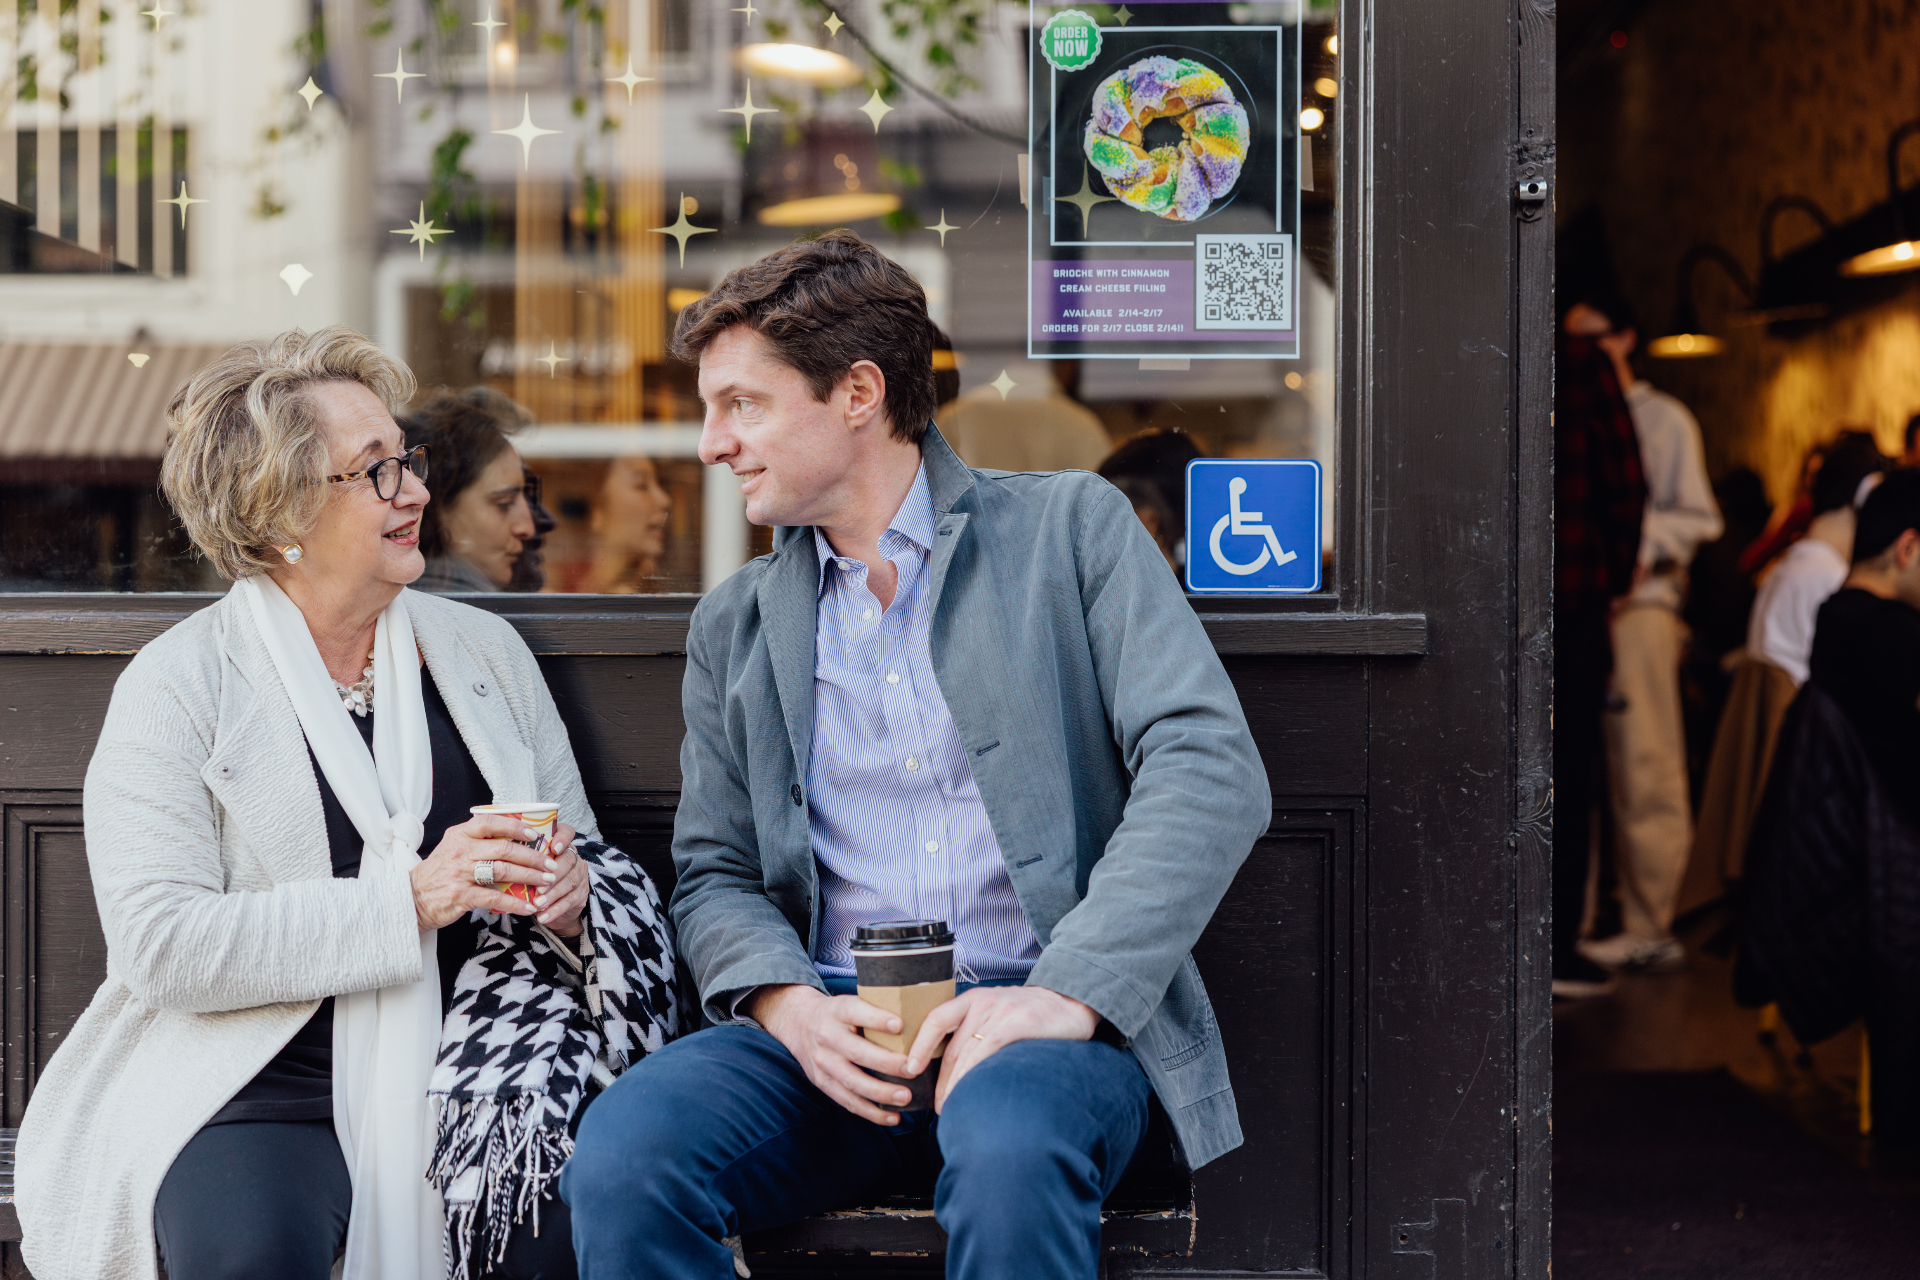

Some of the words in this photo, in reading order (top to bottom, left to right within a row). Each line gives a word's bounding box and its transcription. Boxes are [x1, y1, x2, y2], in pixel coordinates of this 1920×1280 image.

[1053, 26, 1088, 39] ORDER
[1053, 39, 1089, 57] NOW
[1053, 269, 1094, 278] BRIOCHE
[1096, 269, 1119, 278] WITH
[1121, 269, 1170, 278] CINNAMON
[1059, 284, 1093, 293] CREAM
[1095, 284, 1131, 293] CHEESE
[1062, 309, 1113, 318] AVAILABLE
[1118, 309, 1163, 318] 2/14-2/17
[1042, 324, 1079, 333] ORDERS
[1081, 324, 1100, 333] FOR
[1102, 324, 1123, 333] 2/17
[1124, 324, 1154, 333] CLOSE
[1157, 324, 1184, 333] 2/14!!
